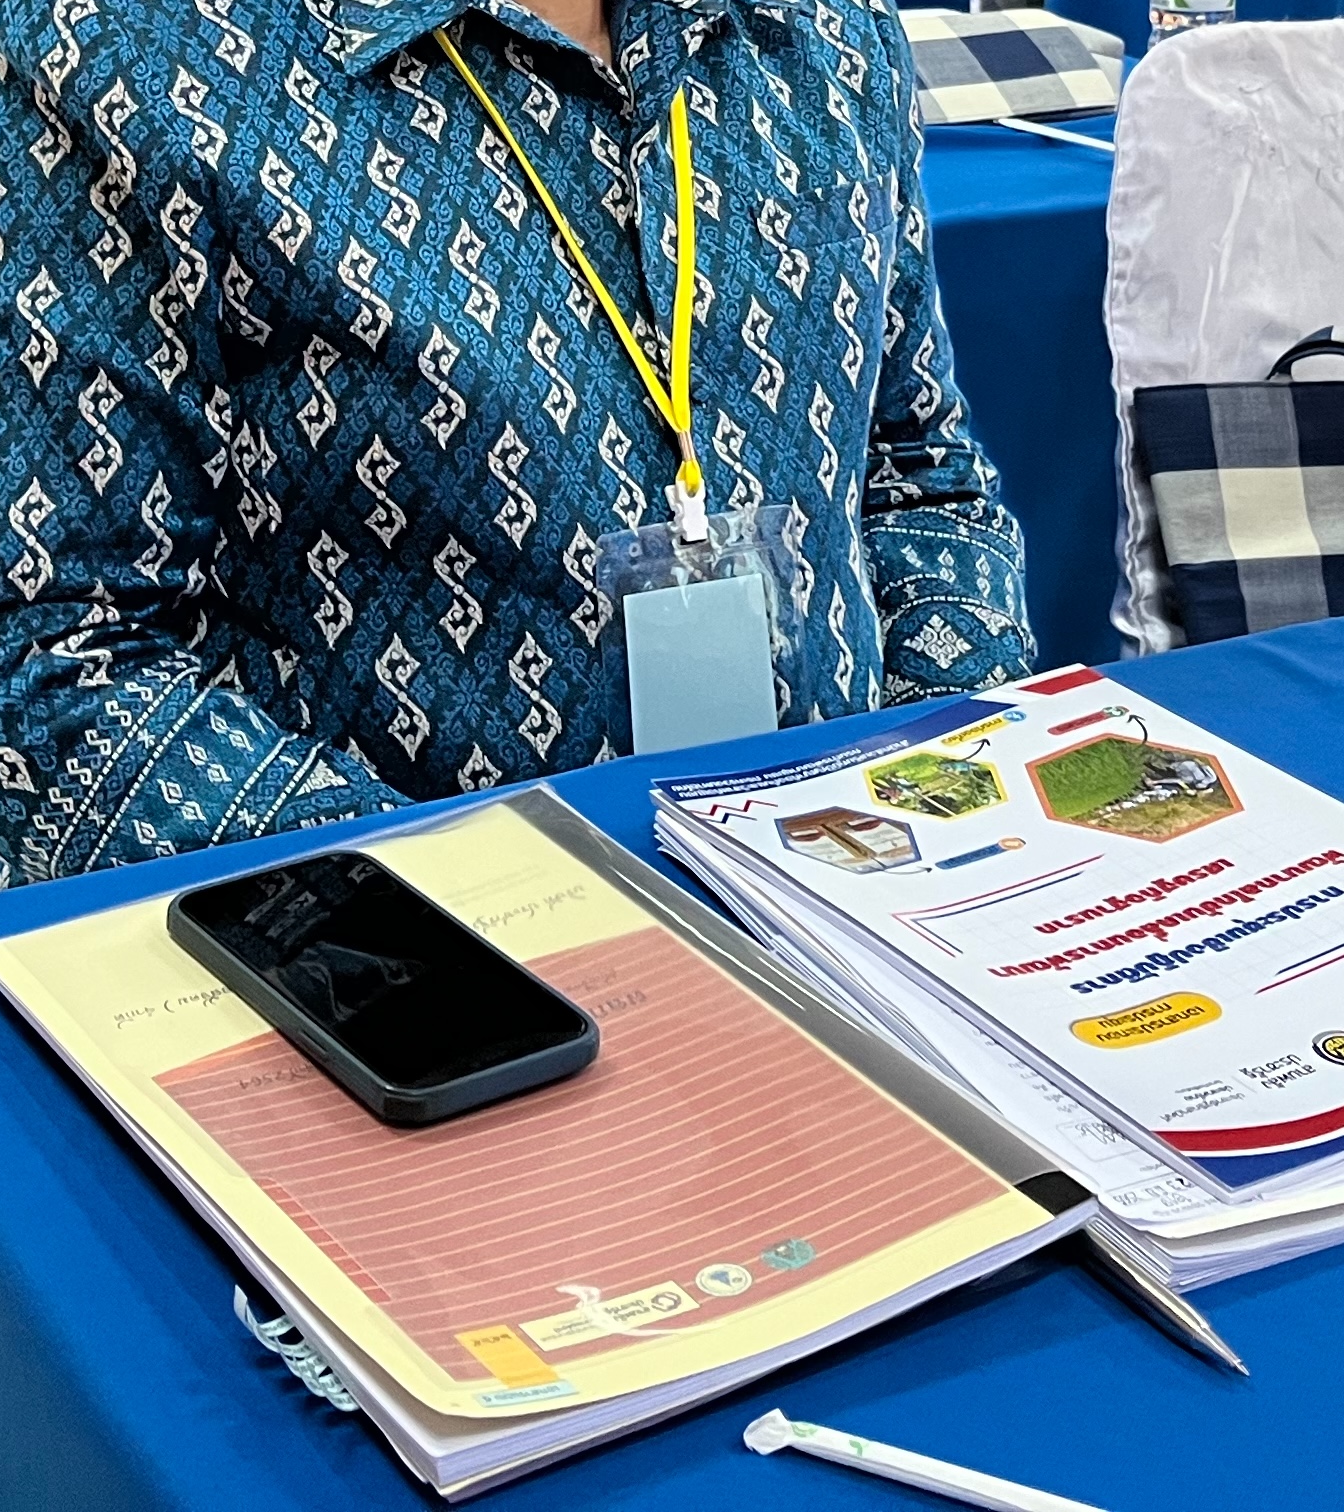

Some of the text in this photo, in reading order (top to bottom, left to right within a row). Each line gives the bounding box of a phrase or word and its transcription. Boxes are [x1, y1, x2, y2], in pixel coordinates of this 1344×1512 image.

[1034, 857, 1236, 936] เศรษฐกิจฐานราก
[472, 902, 539, 934] ประชารัฐ
[1069, 885, 1344, 995] การประชุมเชิงปฏิบัติการ
[1094, 1004, 1206, 1041] เอกสารประกอบ
[1096, 1001, 1174, 1029] การประชุม
[1237, 1053, 1301, 1080] ประชารัฐ
[1259, 1063, 1318, 1089] สานพลัง
